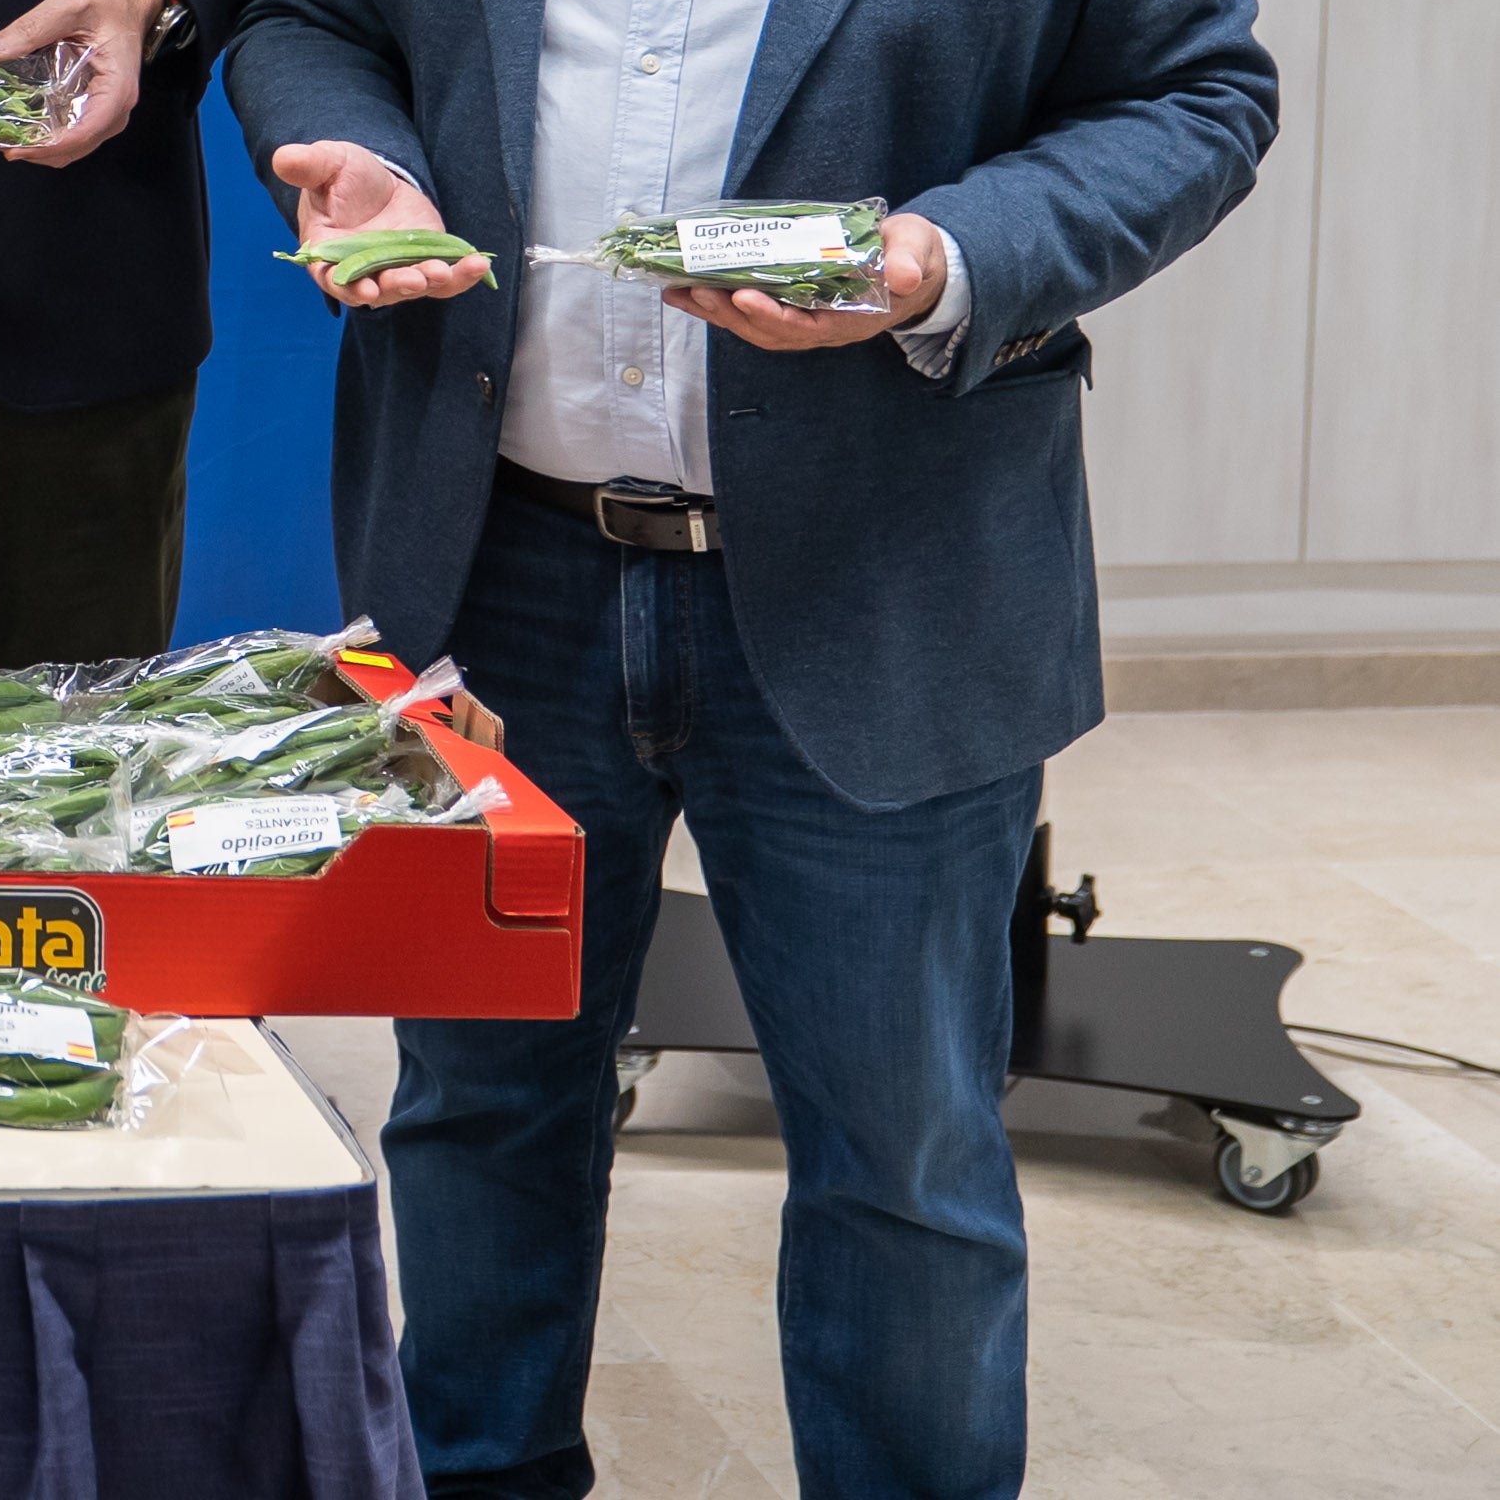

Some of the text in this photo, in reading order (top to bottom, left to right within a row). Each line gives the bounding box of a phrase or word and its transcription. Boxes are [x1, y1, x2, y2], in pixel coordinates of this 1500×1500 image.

[694, 220, 792, 239] agroejido
[689, 237, 770, 252] GUISANTES
[736, 250, 766, 259] 100g
[250, 806, 281, 815] 100g
[244, 816, 329, 830] GUISANTES
[221, 830, 324, 854] agroejido
